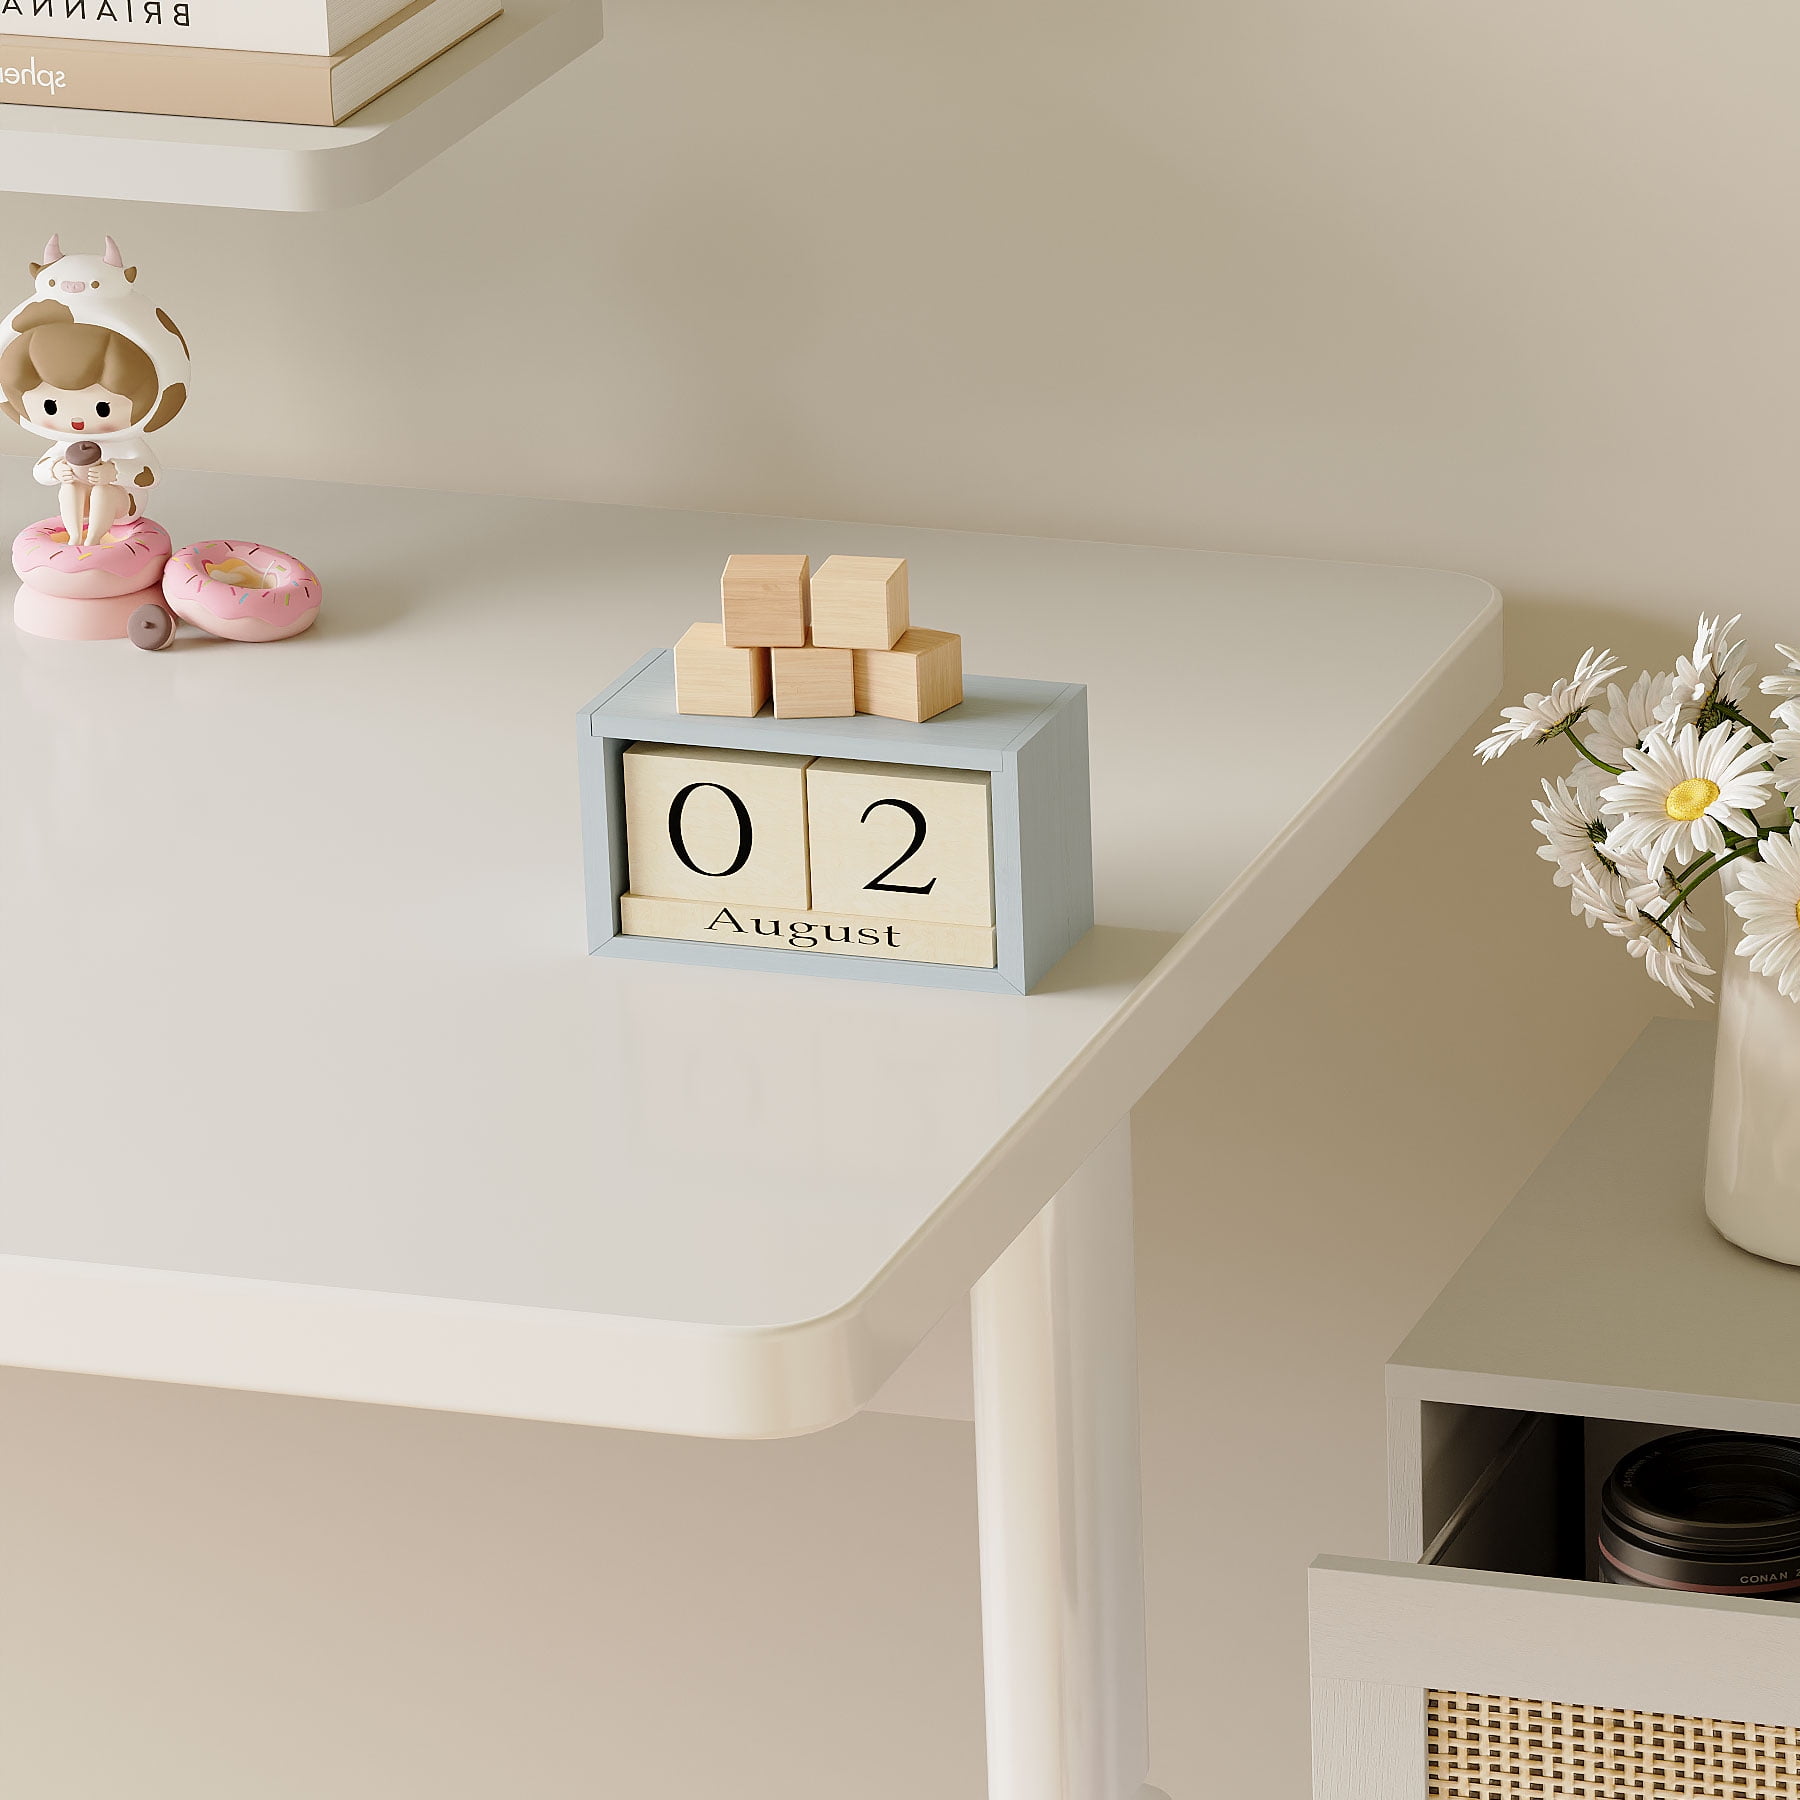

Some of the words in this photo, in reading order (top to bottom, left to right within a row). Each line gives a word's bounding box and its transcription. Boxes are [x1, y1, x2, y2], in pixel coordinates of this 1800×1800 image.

[668, 782, 753, 877] 0
[860, 798, 937, 896] 2
[704, 907, 901, 948] August
[1740, 1571, 1788, 1584] CONAN
